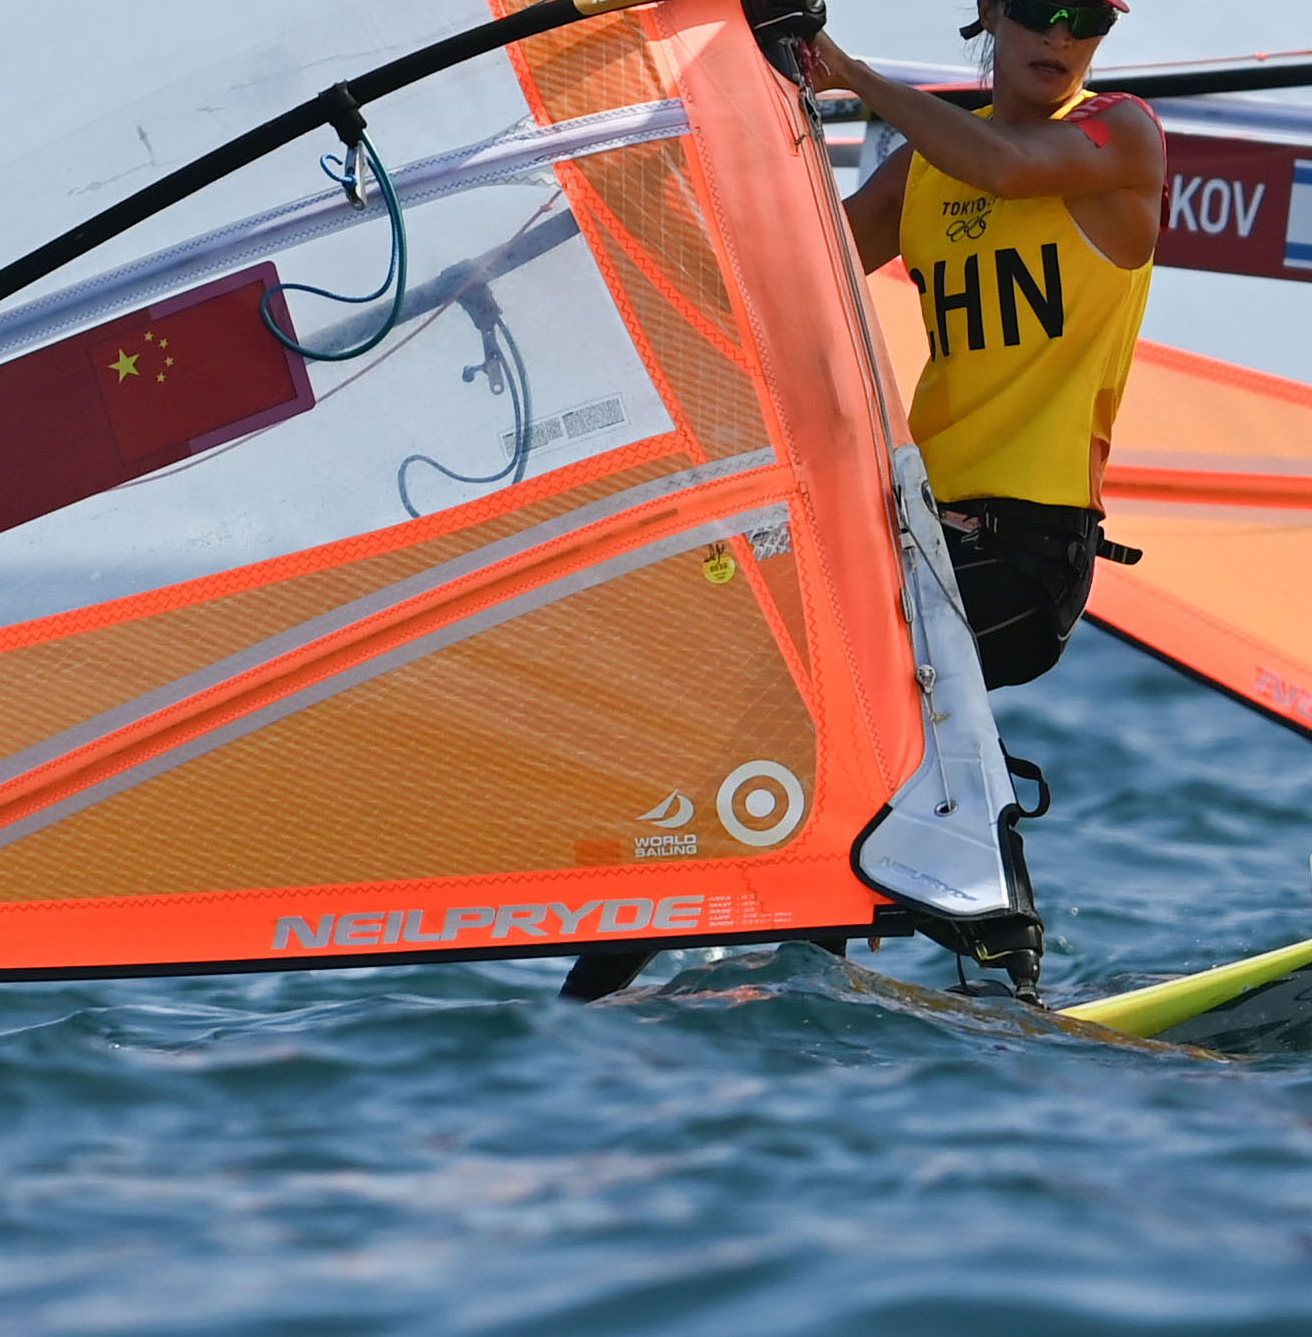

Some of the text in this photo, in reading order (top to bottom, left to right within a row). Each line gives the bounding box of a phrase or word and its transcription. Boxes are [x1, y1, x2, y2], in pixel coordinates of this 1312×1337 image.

[634, 834, 697, 847] WORLD
[635, 845, 697, 858] SAILING
[271, 894, 704, 950] NEILPRYDE
